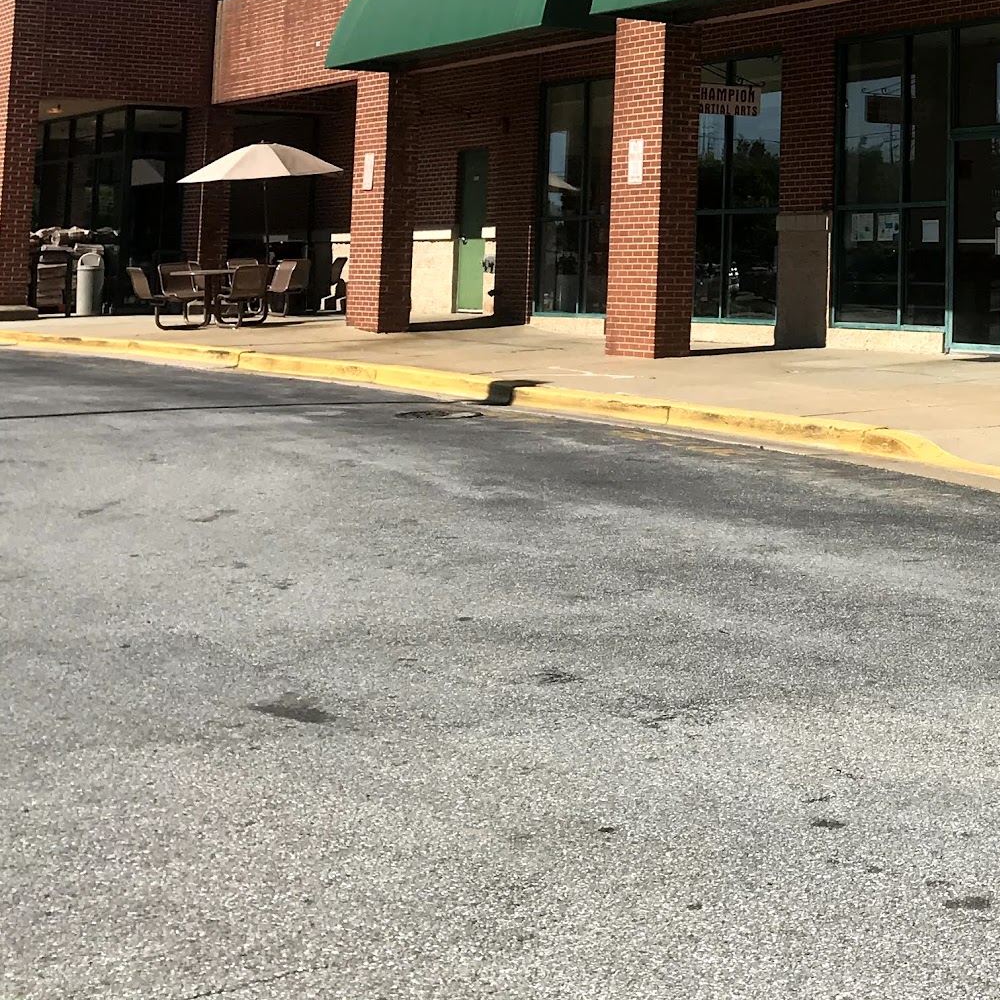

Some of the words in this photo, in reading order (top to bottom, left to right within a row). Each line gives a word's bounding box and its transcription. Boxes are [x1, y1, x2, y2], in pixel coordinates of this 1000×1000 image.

[701, 87, 755, 103] HAMPION
[699, 103, 731, 114] ARTIAL
[734, 105, 758, 116] ARTS
